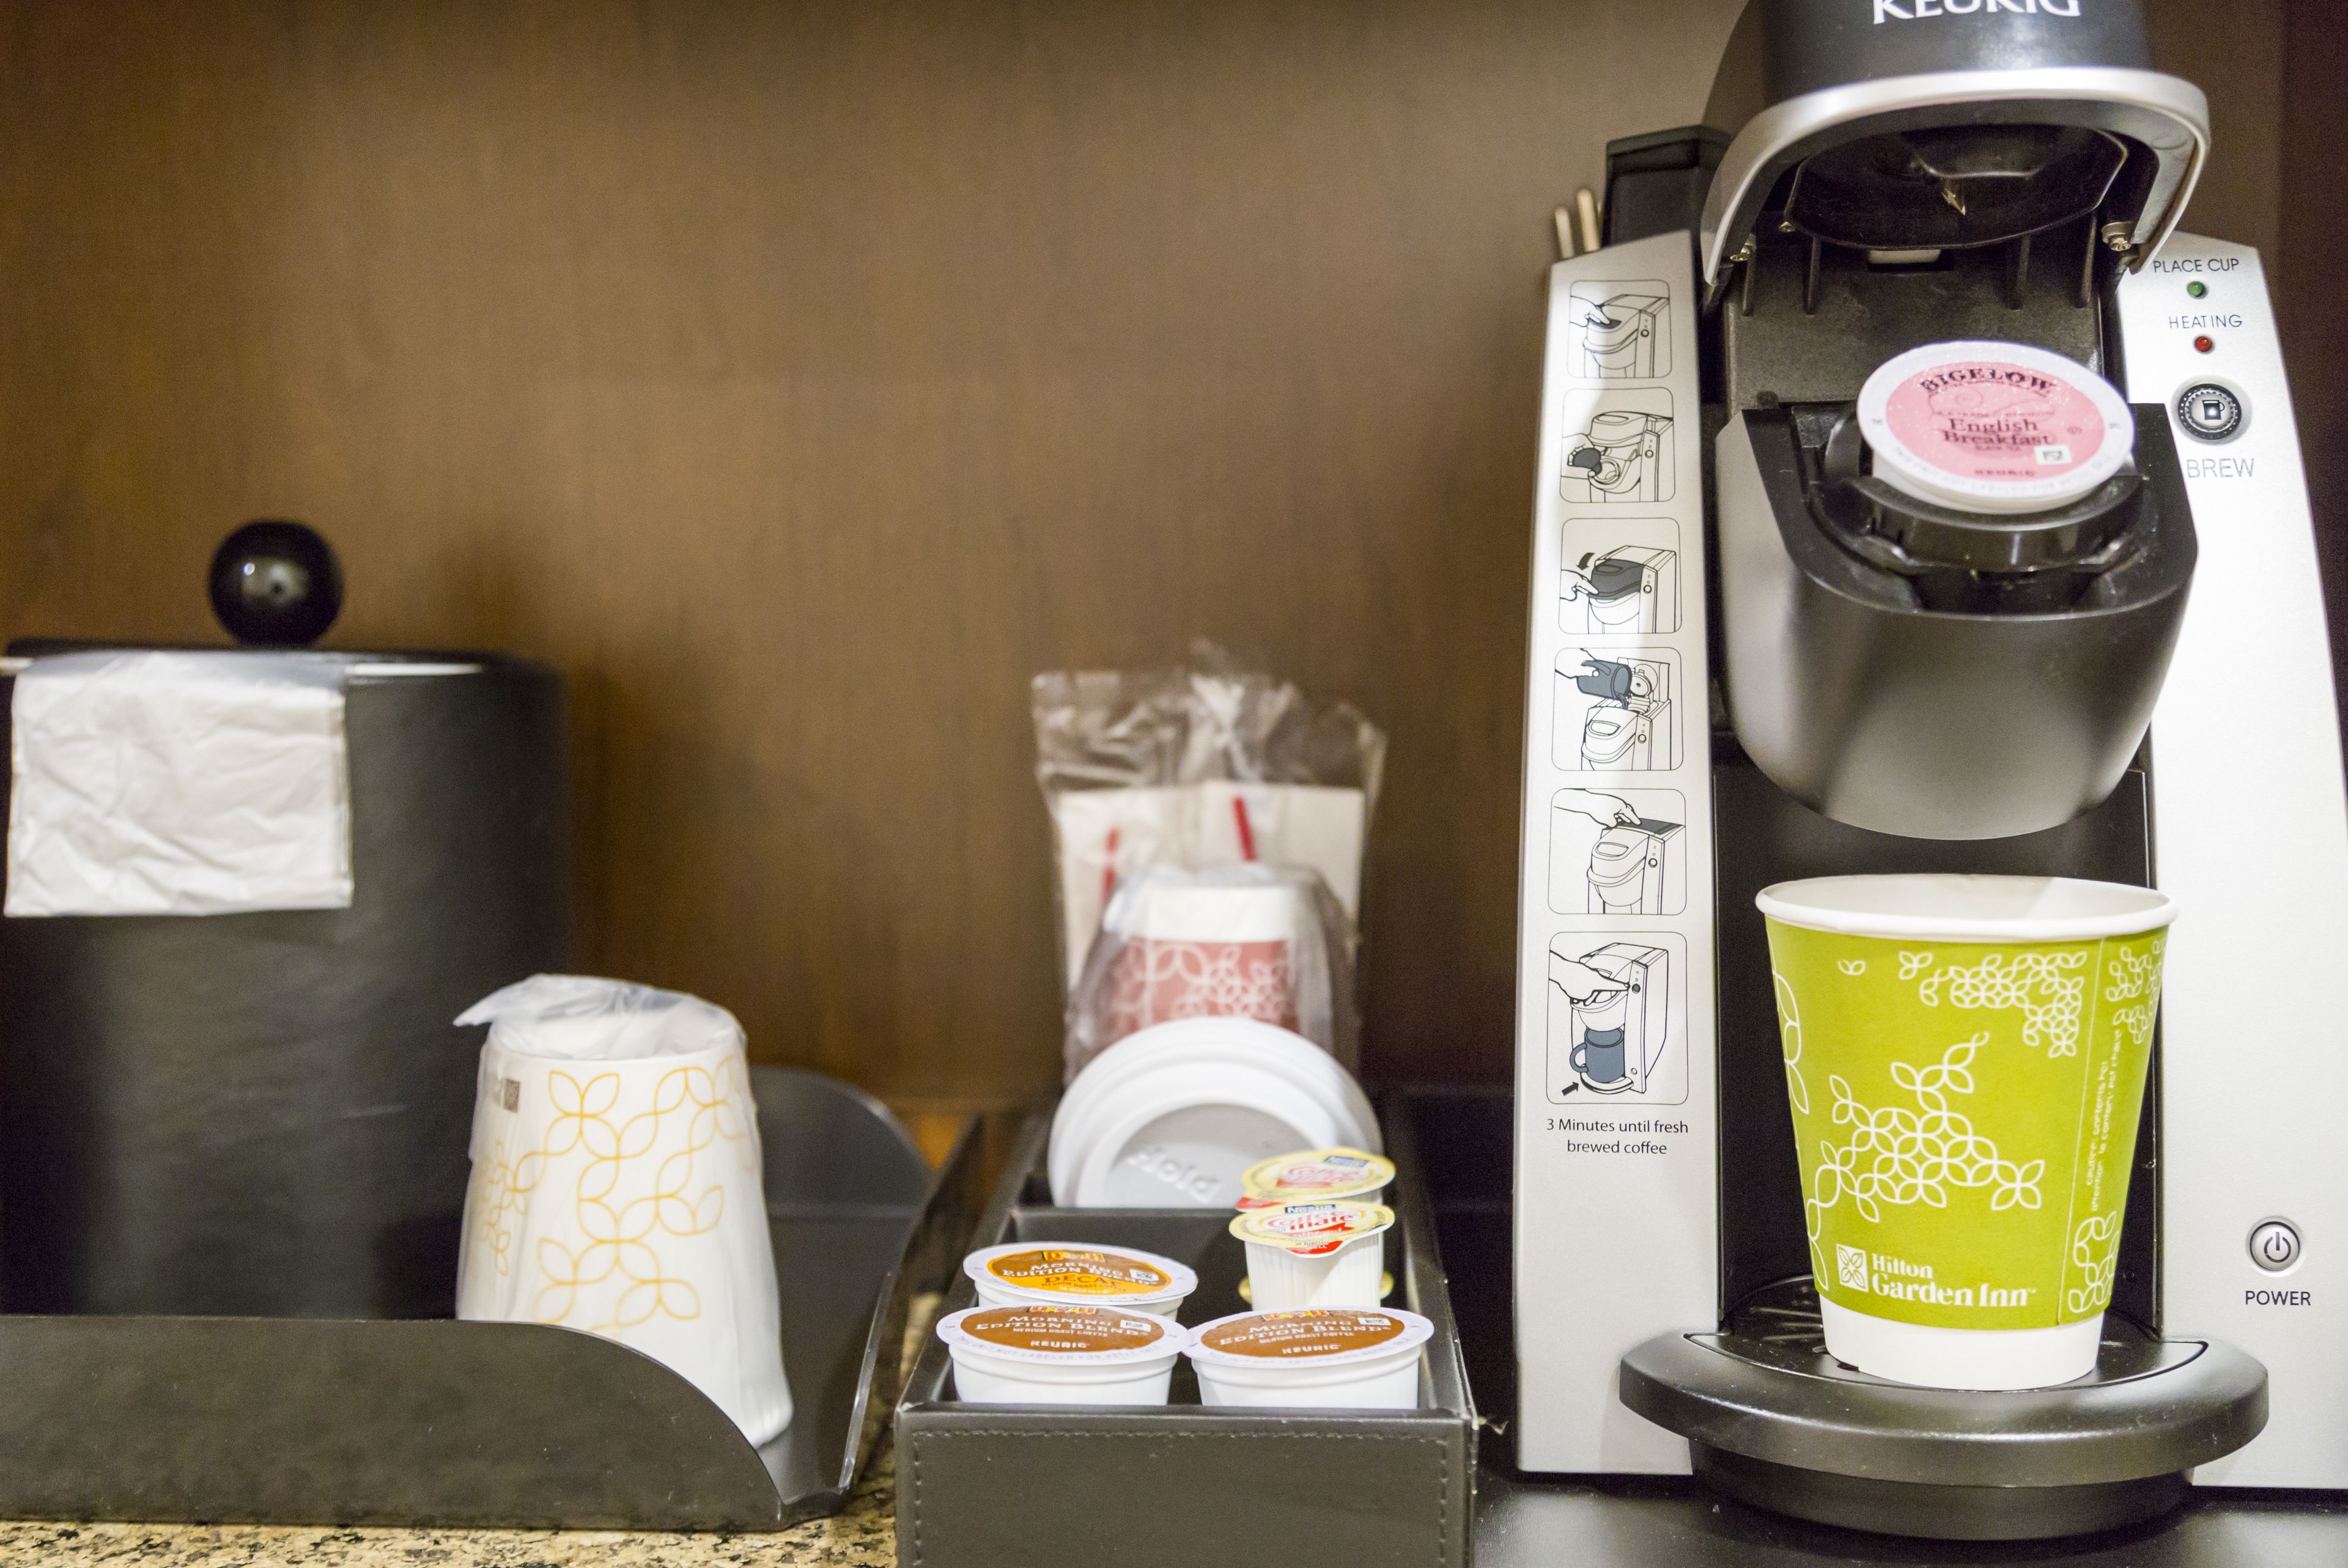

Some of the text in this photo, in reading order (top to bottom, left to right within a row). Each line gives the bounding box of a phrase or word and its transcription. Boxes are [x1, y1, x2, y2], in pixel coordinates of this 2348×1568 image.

[2153, 258, 2240, 273] PLACE CUP
[2169, 314, 2243, 329] HEATING
[1920, 368, 2056, 392] BIGELOW
[1948, 418, 2038, 435] English
[1942, 430, 2052, 446] Breakfast
[2186, 458, 2254, 478] BREW
[1546, 1118, 1688, 1133] 3 Minutes until fresh
[1567, 1139, 1667, 1154] brewed coffee
[1872, 1253, 1933, 1279] Hilton
[1045, 1275, 1122, 1286] DECAF
[1872, 1273, 2029, 1307] Garden Inn
[2245, 1290, 2311, 1306] POWER
[1008, 1316, 1112, 1326] MORNING
[975, 1322, 1139, 1336] EDITION BLEND
[1219, 1328, 1305, 1345] EDITION
[1030, 1339, 1087, 1349] KEURIG
[1282, 1344, 1340, 1354] KEURIG
